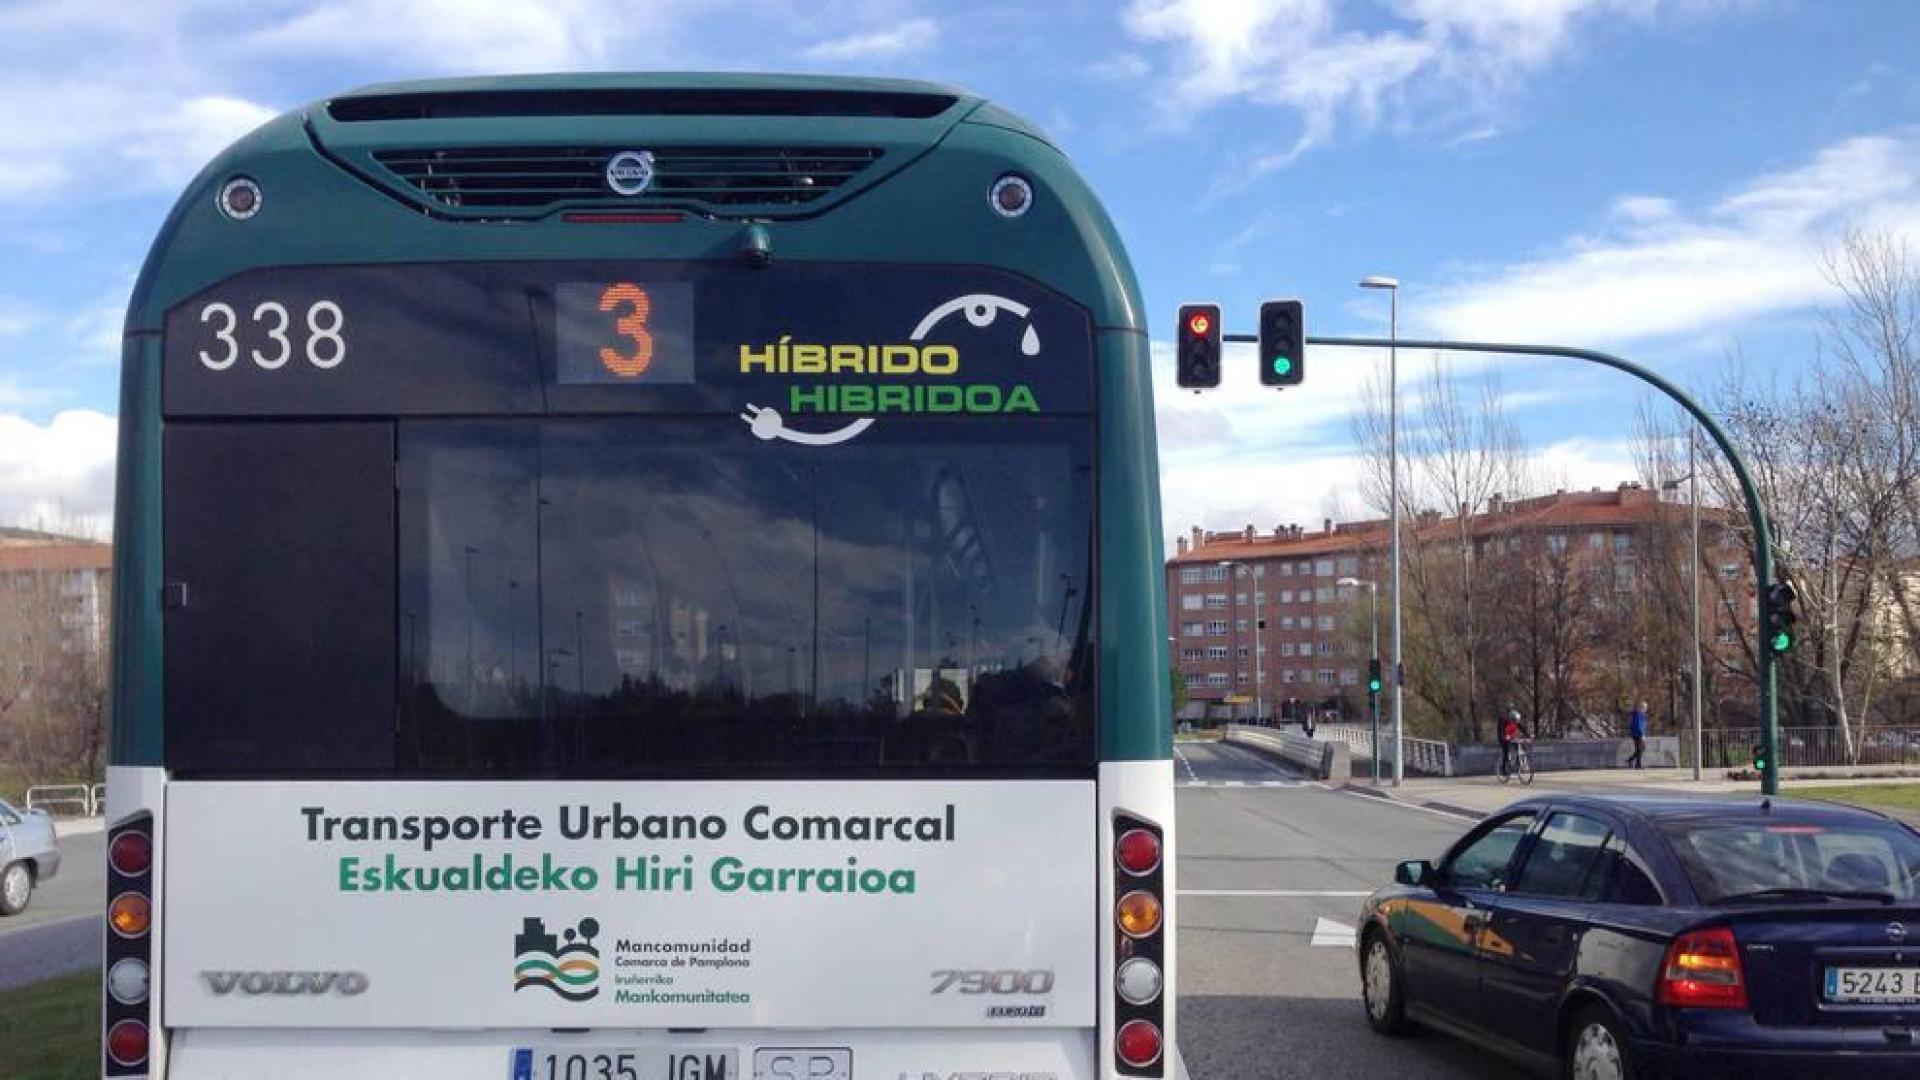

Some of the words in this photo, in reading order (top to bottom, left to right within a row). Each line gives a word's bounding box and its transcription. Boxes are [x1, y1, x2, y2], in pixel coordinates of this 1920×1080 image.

[199, 300, 346, 371] 338
[599, 282, 653, 376] 3
[740, 335, 959, 374] HÍBRIDO
[789, 384, 1041, 414] HIBRIDOA
[302, 806, 543, 851] Transporte
[559, 803, 727, 840] Urbano
[743, 804, 955, 842] Comarcal
[339, 854, 598, 891] Eskualdeko
[616, 854, 693, 891] Hiri
[710, 856, 915, 894] Garraioa
[615, 938, 751, 953] Mancomunidad
[615, 956, 668, 967] Comarca
[671, 956, 686, 967] de
[689, 956, 750, 970] Pamplona
[203, 970, 370, 995] VOLVO
[930, 969, 1054, 994] 7900
[1843, 971, 1904, 994] 5243
[615, 988, 750, 1004] Mankomunitatea
[546, 1054, 637, 1080] 1035
